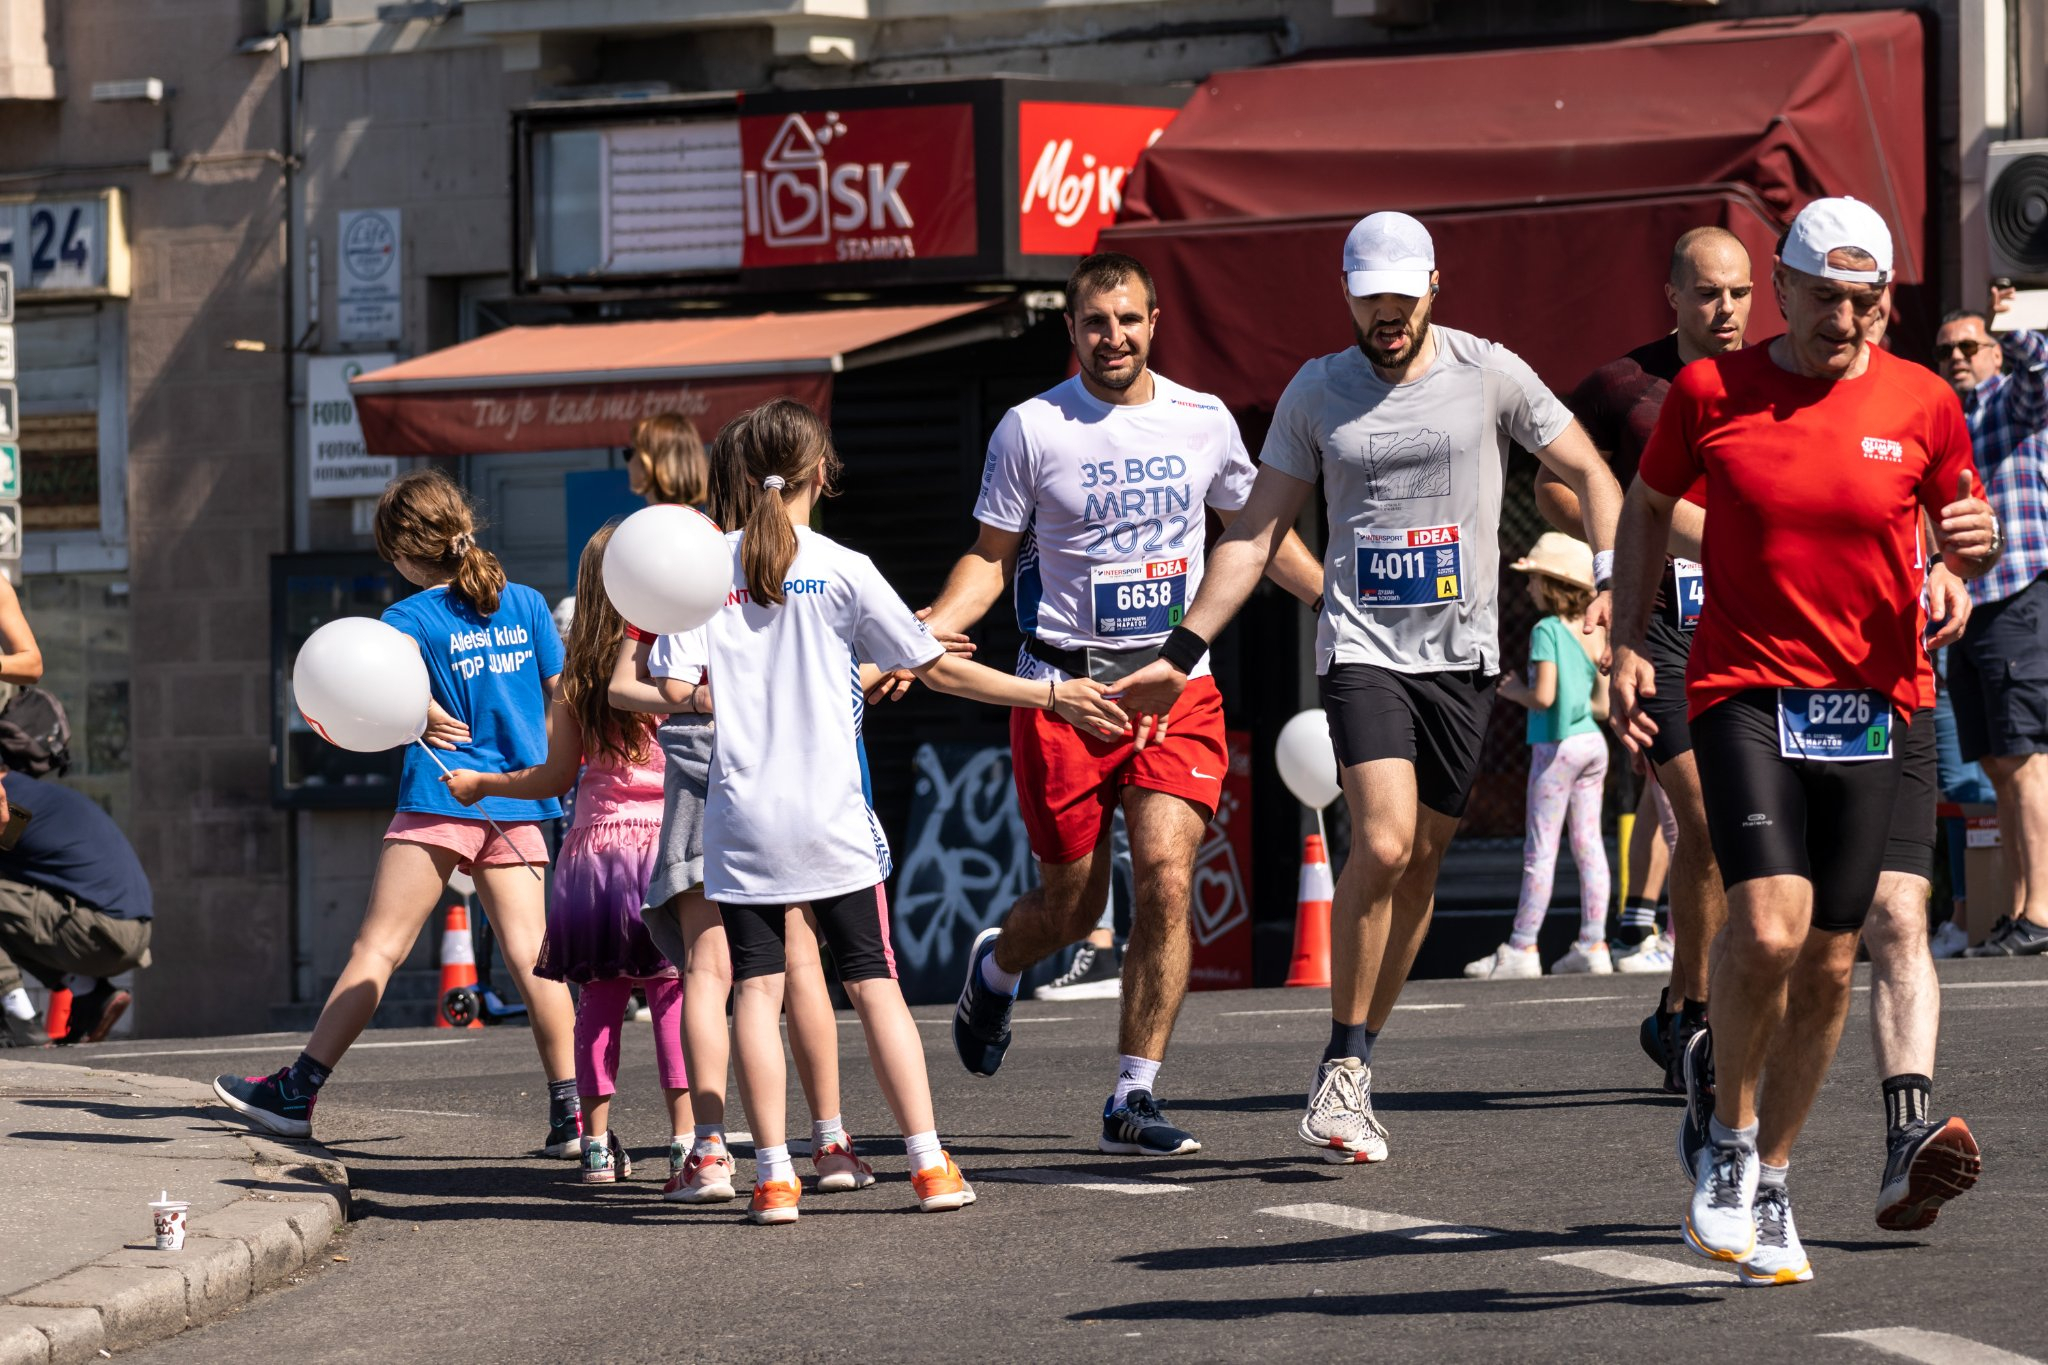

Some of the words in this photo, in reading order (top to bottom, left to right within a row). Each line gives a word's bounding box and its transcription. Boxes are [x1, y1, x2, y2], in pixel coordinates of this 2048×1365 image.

[312, 402, 352, 426] FOTO
[546, 388, 598, 424] kad
[602, 389, 640, 420] mi
[1084, 483, 1190, 522] MRTN
[1084, 515, 1190, 555] 2022
[1365, 534, 1403, 542] INTERSPORT
[1104, 567, 1142, 576] INTERSPORT
[1370, 551, 1425, 580] 4011
[1117, 581, 1172, 610] 6638
[1443, 580, 1453, 594] A
[1173, 609, 1179, 622] D
[494, 624, 528, 646] klub
[1808, 693, 1870, 725] 6226
[1873, 731, 1880, 747] D
